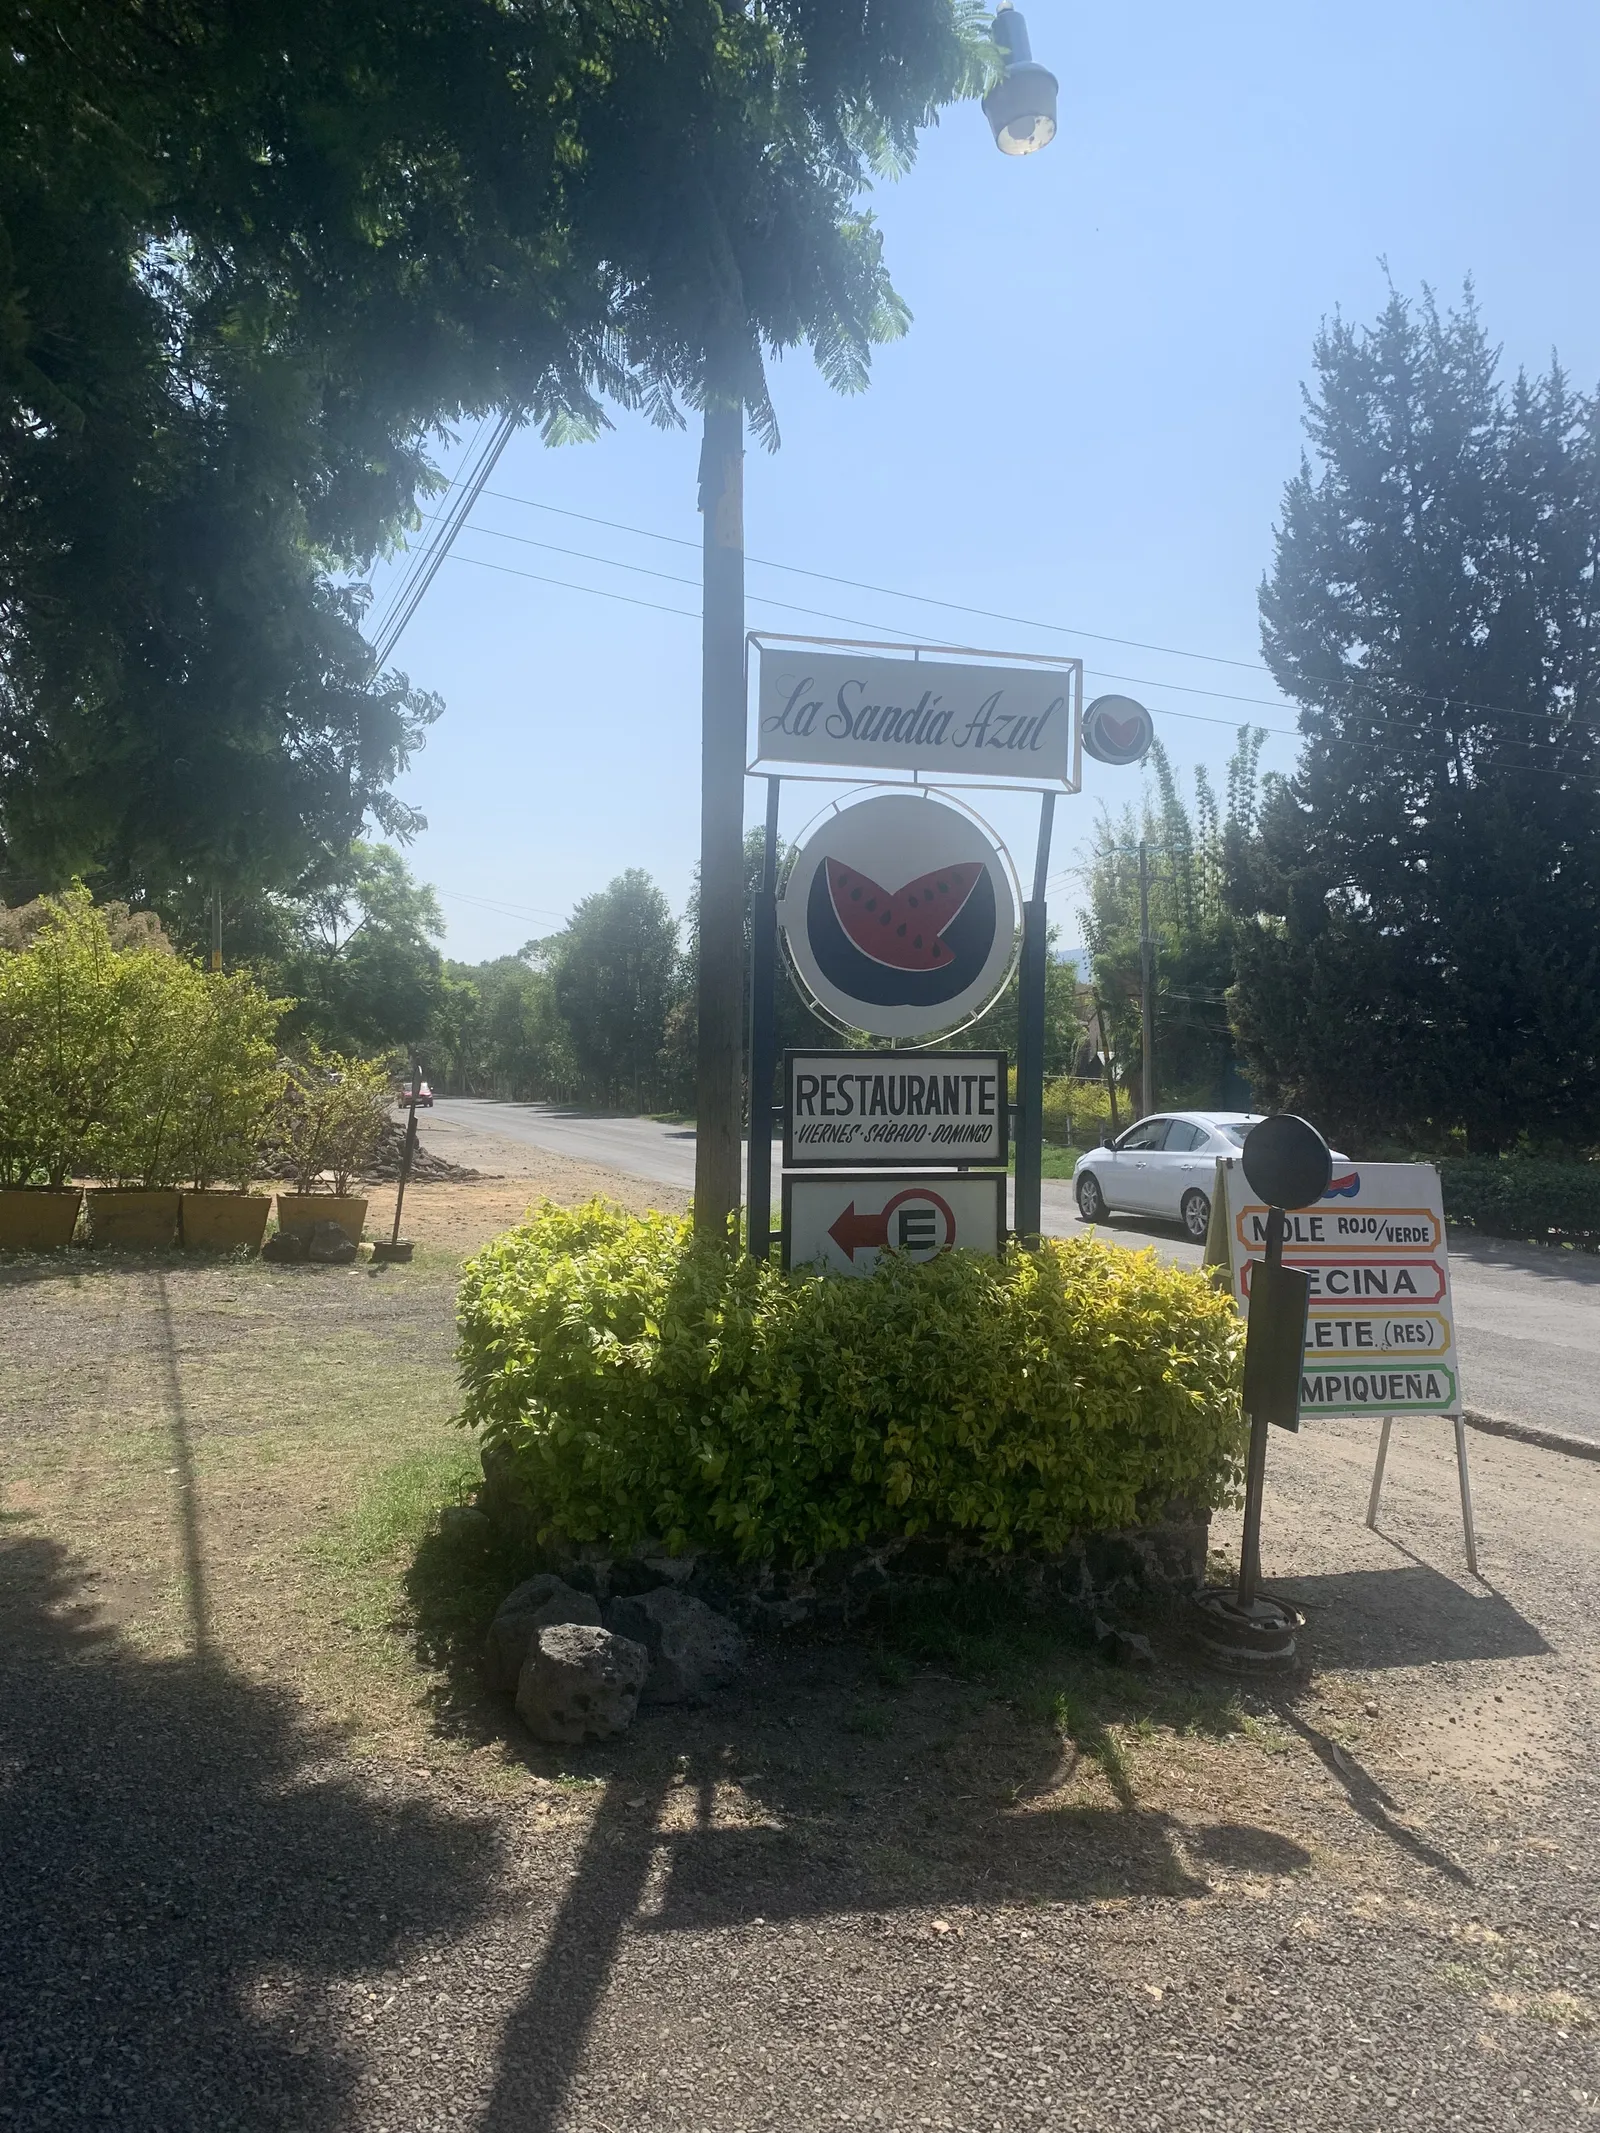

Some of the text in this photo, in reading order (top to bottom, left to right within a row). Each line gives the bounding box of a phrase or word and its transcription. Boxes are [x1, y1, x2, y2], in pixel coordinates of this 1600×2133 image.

[761, 673, 1065, 752] La Sandía Azul
[796, 1074, 996, 1117] RESTAURANTE
[931, 1124, 994, 1145] DOMINGO
[898, 1209, 936, 1250] E
[1302, 1269, 1418, 1295] ECINA
[1385, 1320, 1434, 1347] (RES)
[1301, 1374, 1442, 1403] MPIQUEÑA
